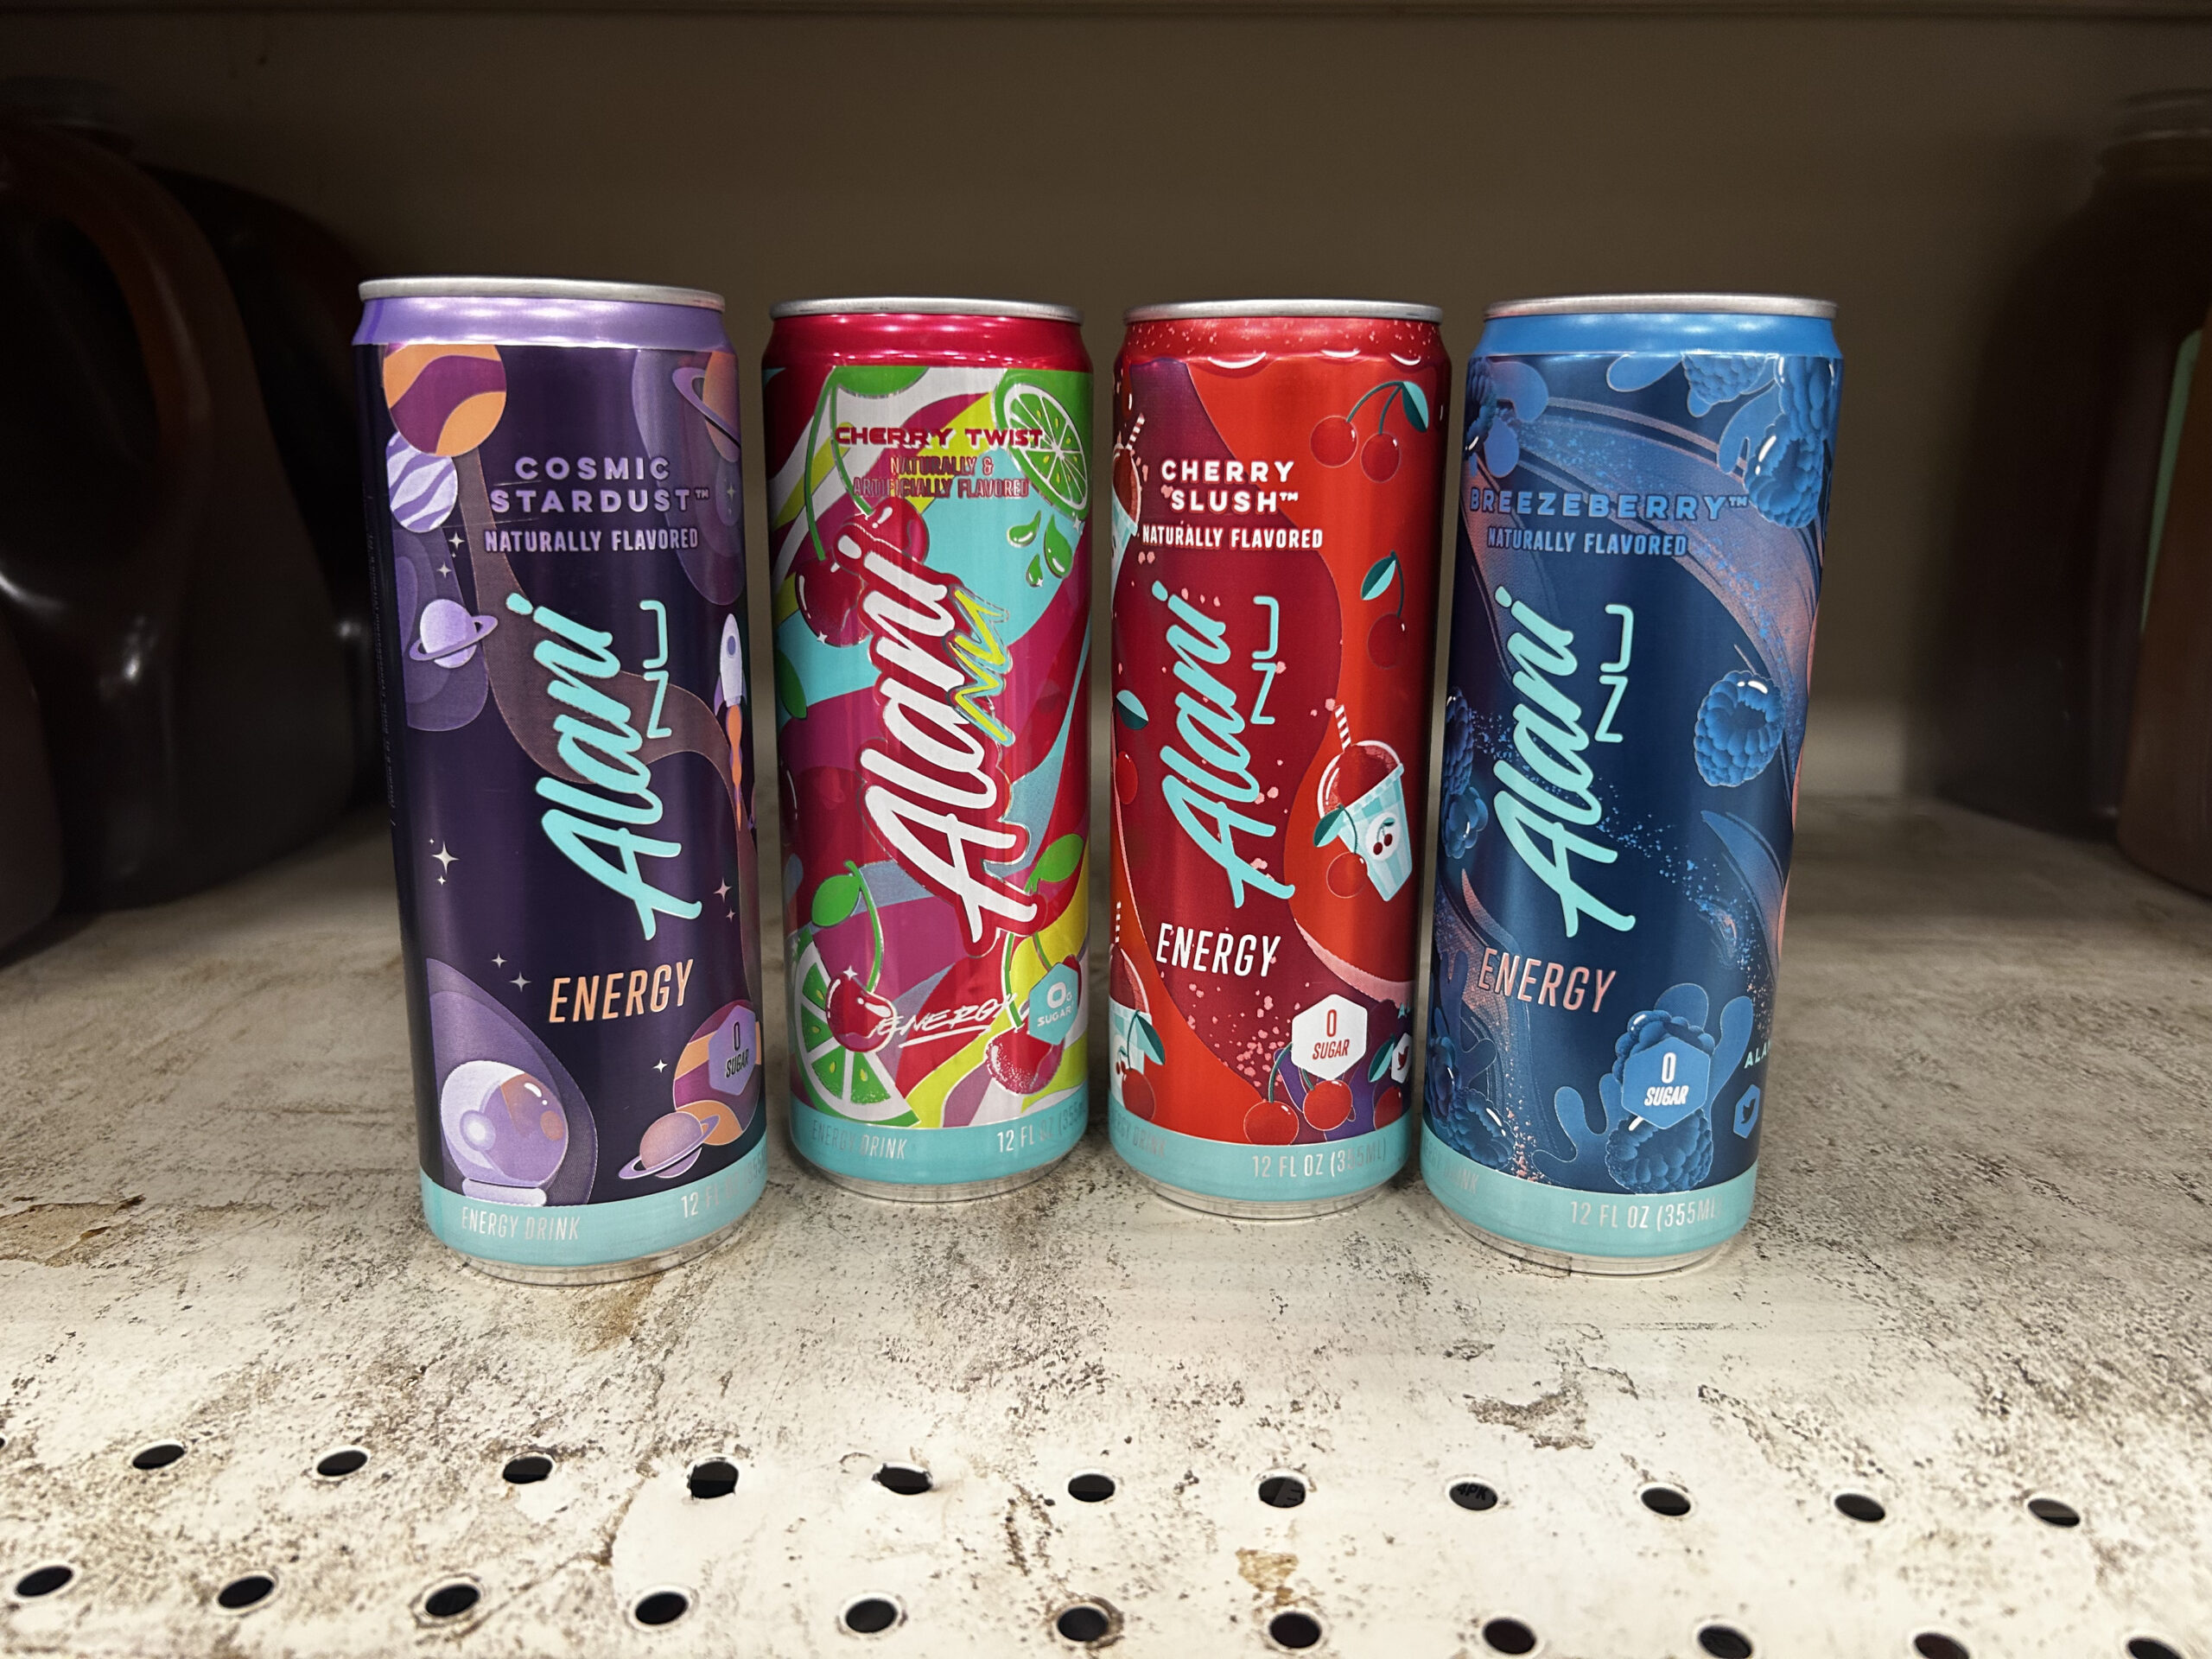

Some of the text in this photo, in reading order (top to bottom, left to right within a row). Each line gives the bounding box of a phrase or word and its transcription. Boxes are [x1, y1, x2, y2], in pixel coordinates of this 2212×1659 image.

[835, 427, 1044, 449] CHERRY TWIST
[514, 456, 671, 480] COSMIC
[890, 455, 995, 476] NATURALLY &
[1160, 459, 1295, 484] CHERRY
[853, 476, 1031, 499] ARTIFICIALLY FLAVORED
[485, 527, 699, 553] NATURALLY FLAVORED
[1142, 524, 1324, 549] NATURALLY FLAVORED
[1487, 527, 1688, 556] NATURALLY FLAVORED
[836, 534, 1039, 944] Alani
[1151, 580, 1295, 909] Alani
[505, 592, 702, 941] Alani
[1493, 586, 1637, 938] Alani
[1155, 922, 1281, 977] ENERGY
[548, 958, 694, 1023] ENERGY
[1478, 947, 1617, 1014] ENERGY
[733, 1020, 741, 1052] 0
[1325, 1009, 1338, 1038] 0
[725, 1048, 750, 1079] SUGAR
[1312, 1039, 1350, 1061] SUGAR
[1661, 1052, 1676, 1084] 0
[1643, 1085, 1689, 1107] SUGAR
[861, 1134, 908, 1160] DRINK
[996, 1128, 1015, 1153] 12
[1020, 1124, 1035, 1147] FL
[1252, 1154, 1272, 1178] 12
[1279, 1155, 1297, 1178] FL
[1304, 1153, 1324, 1177] OZ
[681, 1192, 699, 1219] 12
[1570, 1200, 1592, 1225] 12
[1599, 1204, 1618, 1229] FL
[1626, 1205, 1650, 1229] OZ
[461, 1206, 581, 1241] ENERGY DRINK
